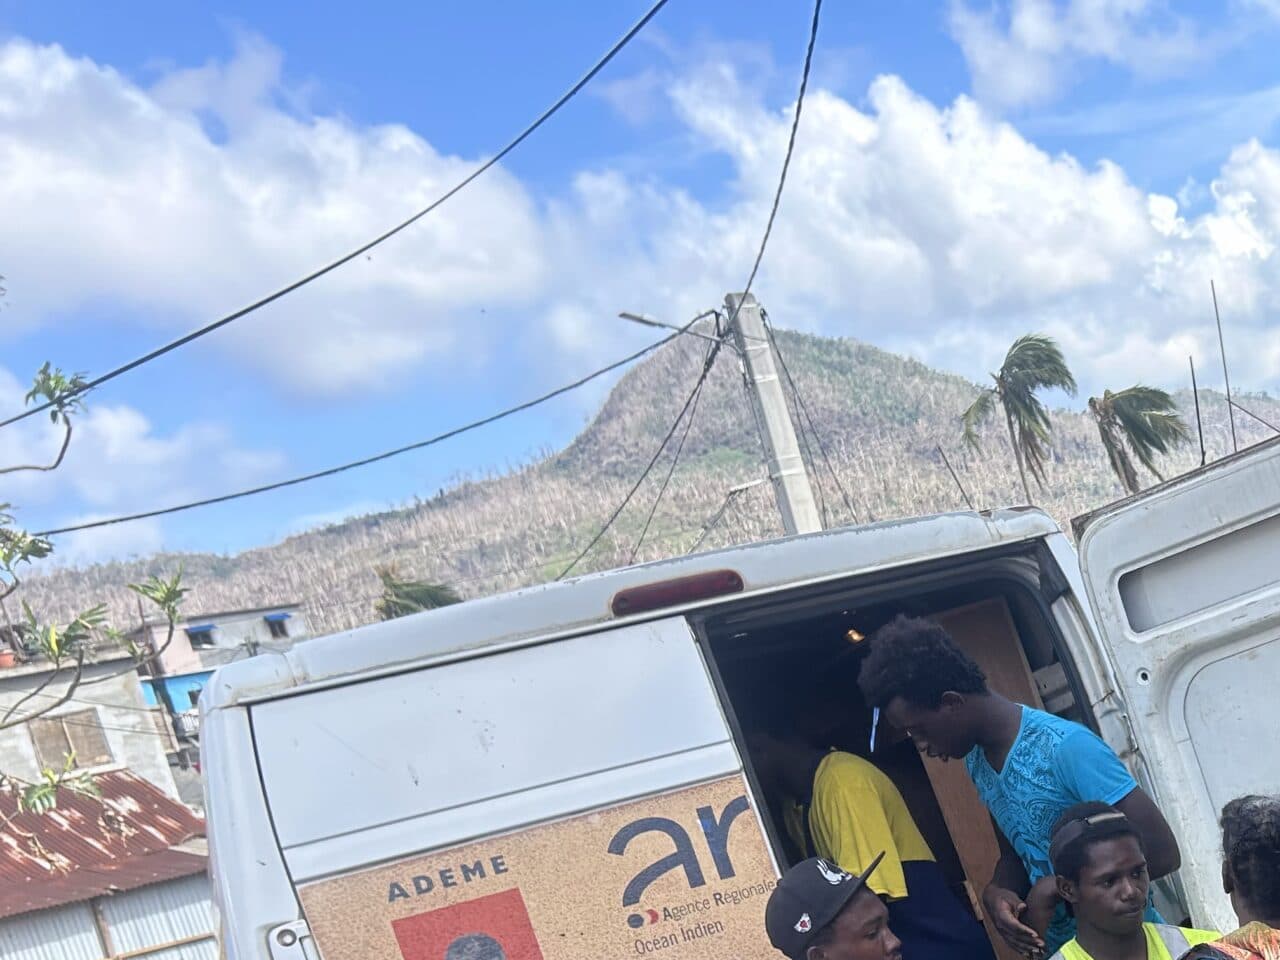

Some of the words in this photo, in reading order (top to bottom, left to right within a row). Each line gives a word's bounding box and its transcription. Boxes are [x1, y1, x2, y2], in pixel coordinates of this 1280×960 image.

[388, 855, 508, 903] ADEME
[663, 897, 711, 922] Agence
[713, 880, 775, 906] Régionale
[634, 933, 679, 955] Océan
[681, 919, 724, 943] Indien
